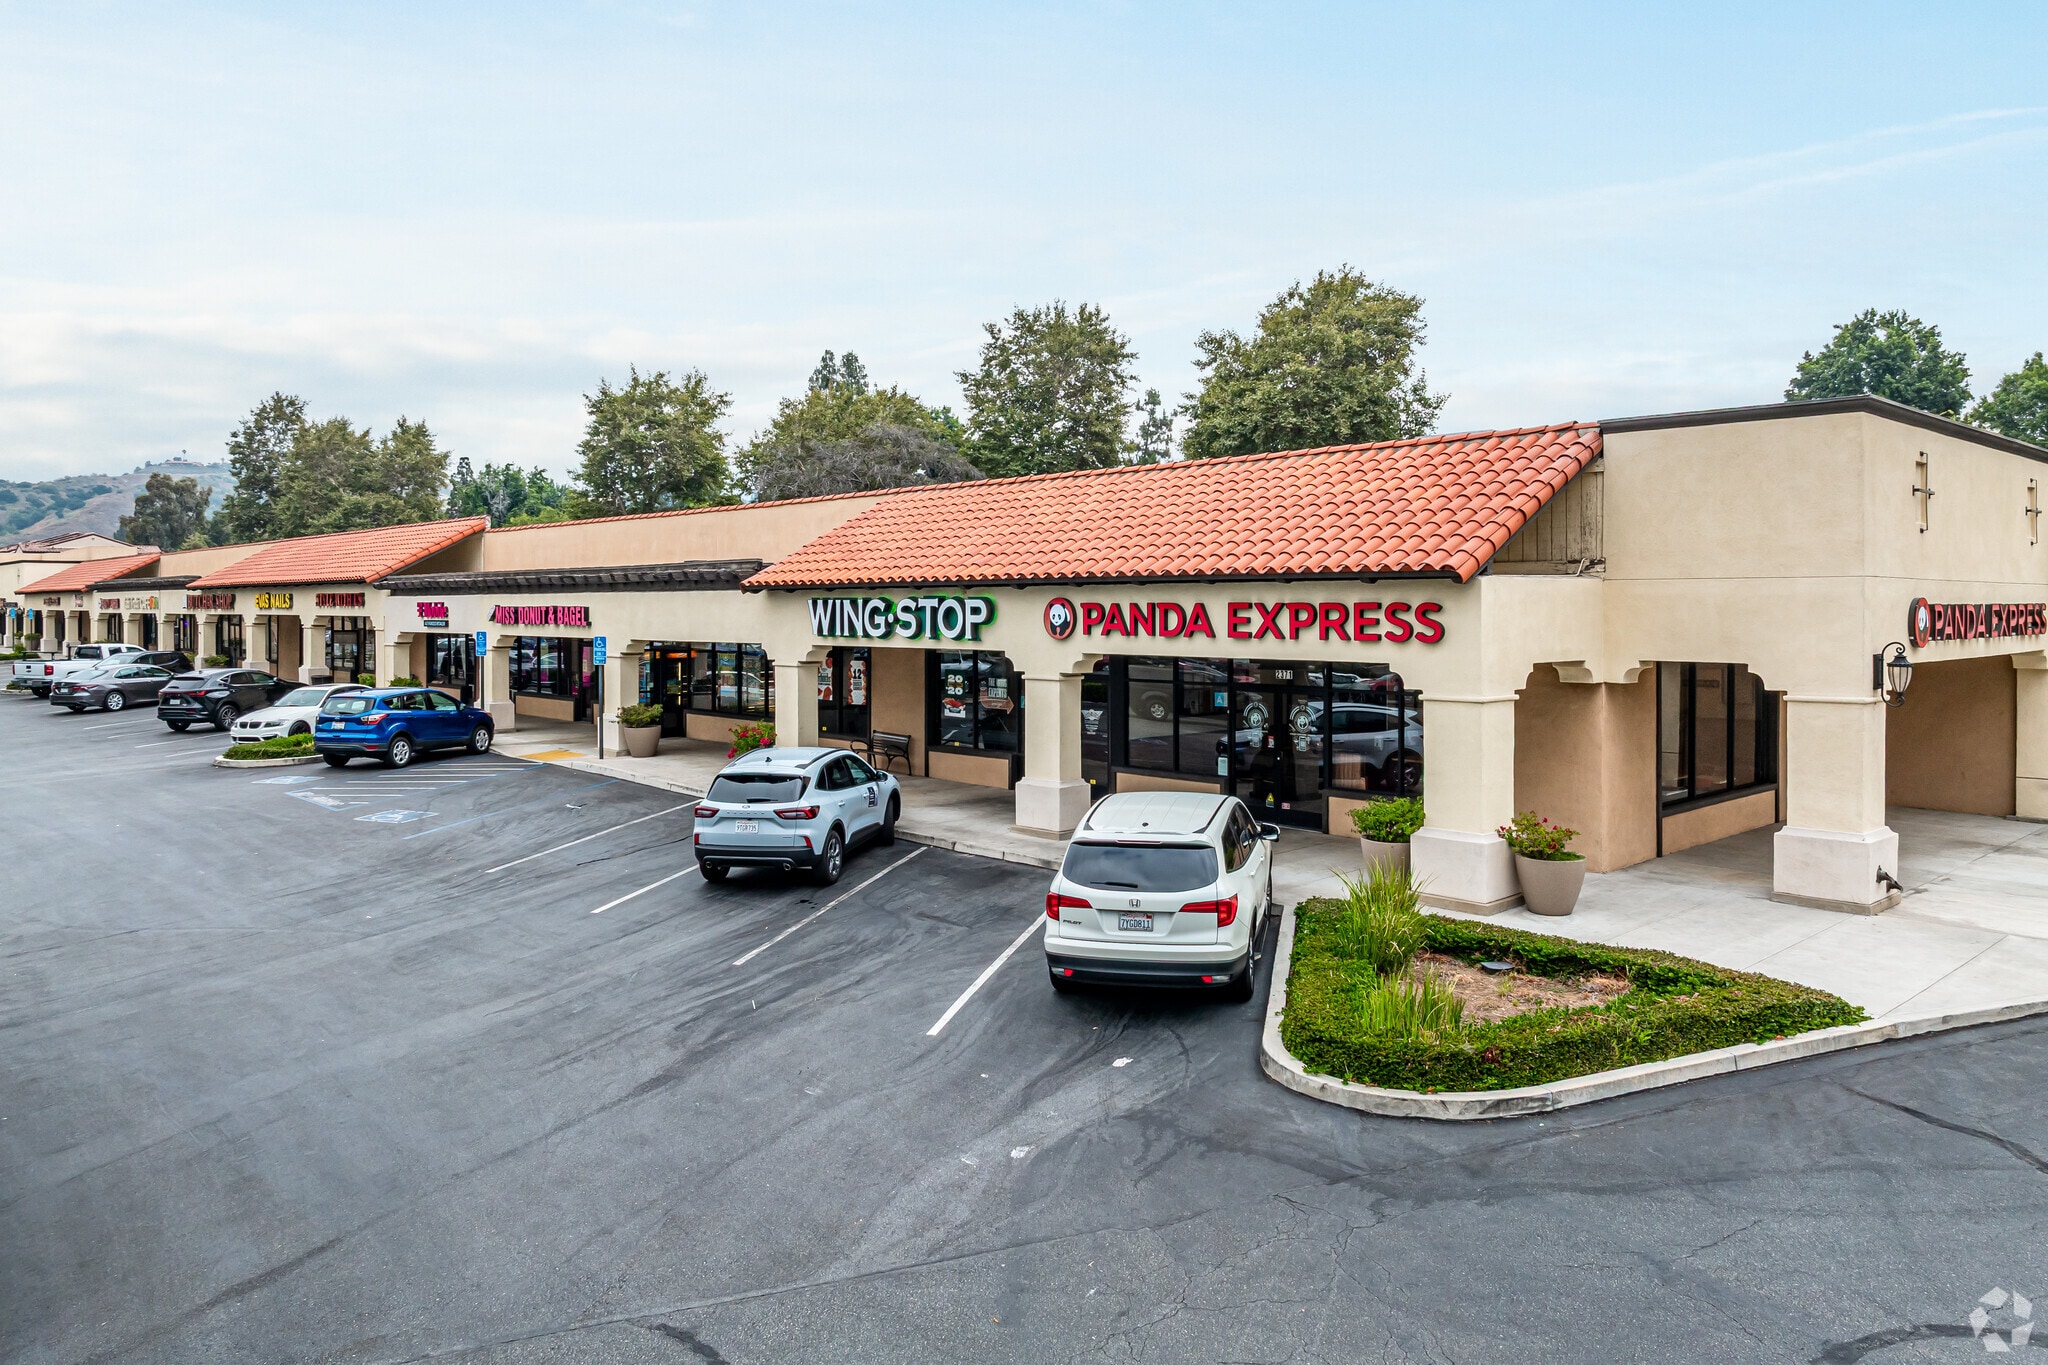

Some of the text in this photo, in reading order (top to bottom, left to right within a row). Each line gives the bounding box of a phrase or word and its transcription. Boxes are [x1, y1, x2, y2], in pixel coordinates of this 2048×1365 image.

[270, 593, 292, 609] NAILS
[495, 606, 587, 627] MISS DONUT & BAGEL
[1082, 601, 1445, 644] PANDA EXPRESS
[1933, 602, 2047, 641] PANDA EXPRESS
[853, 669, 862, 679] 12
[947, 674, 964, 682] 20
[1275, 670, 1293, 680] 2371
